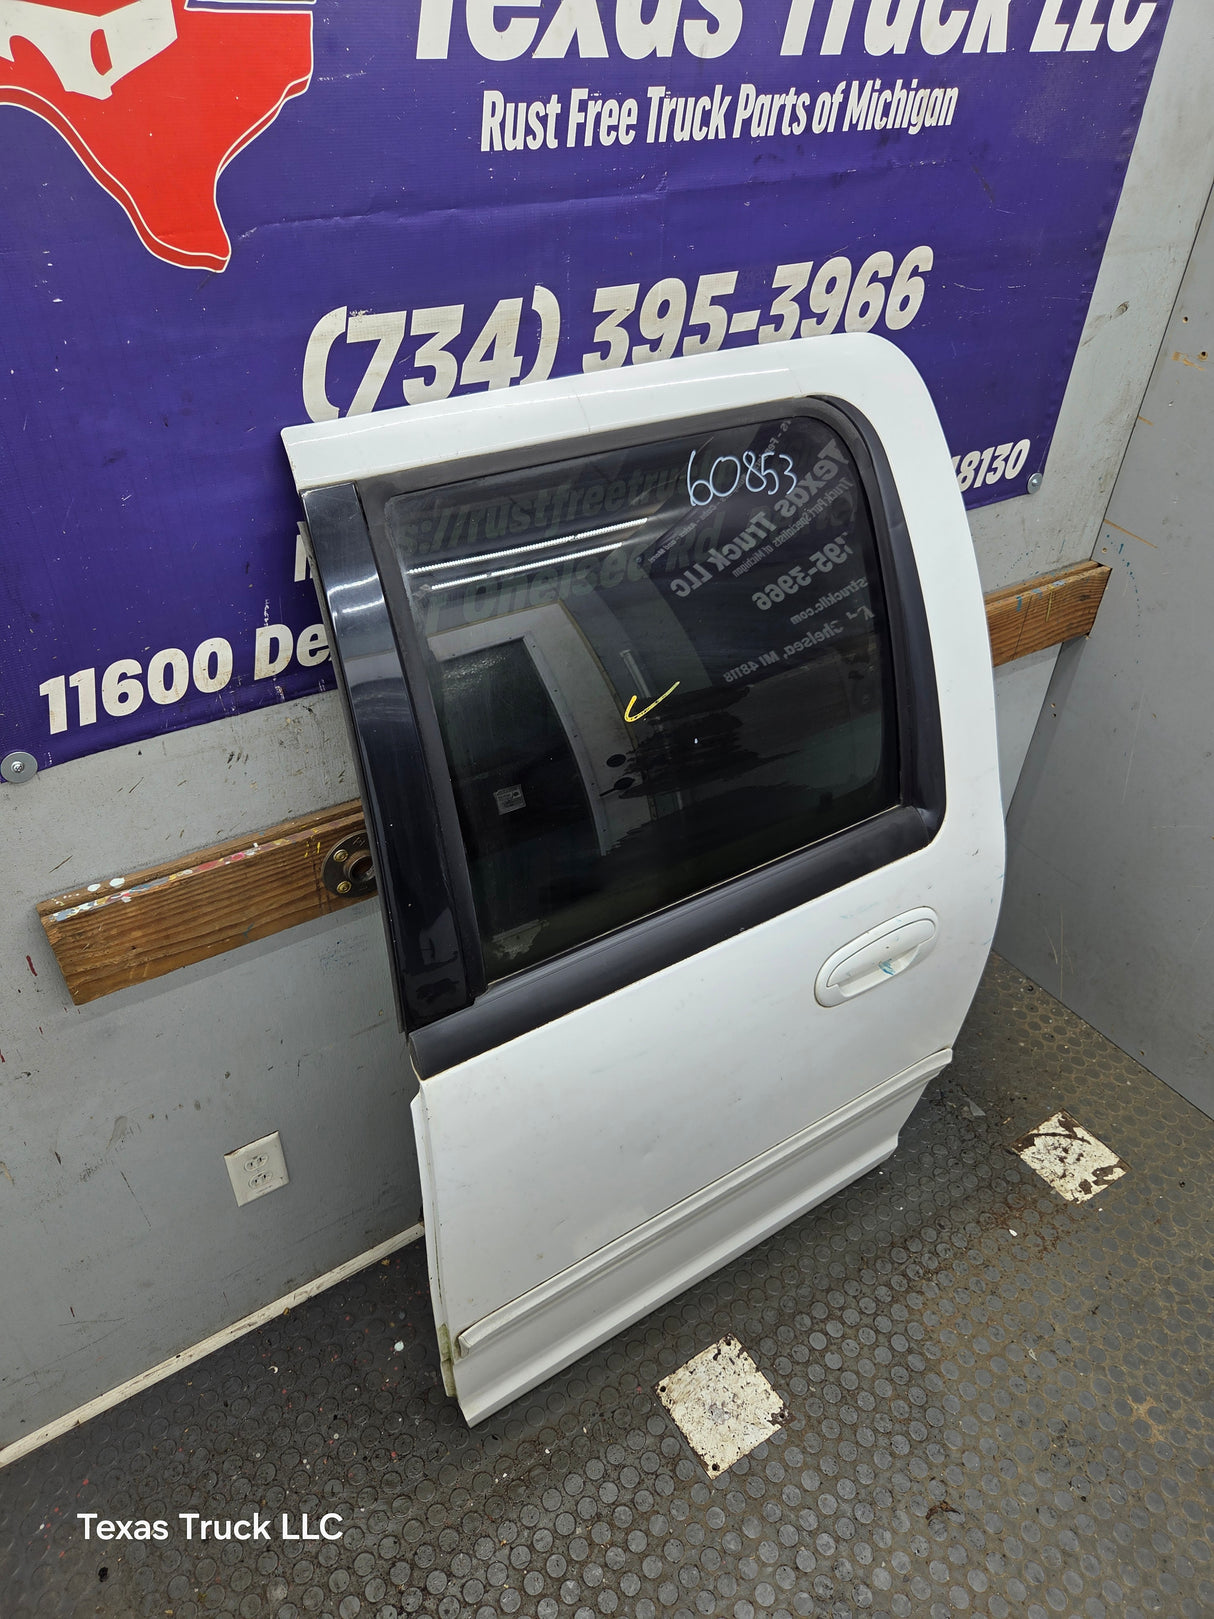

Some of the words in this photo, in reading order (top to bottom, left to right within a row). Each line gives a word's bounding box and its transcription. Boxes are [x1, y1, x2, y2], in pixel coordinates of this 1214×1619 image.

[481, 90, 561, 152] Rust
[566, 88, 638, 148] Free
[646, 84, 735, 143] Truck
[733, 83, 810, 138] Parts
[812, 81, 847, 133] of
[842, 78, 959, 135] Michigan
[302, 284, 561, 423] (734)
[582, 245, 934, 373] 395-3966
[687, 450, 797, 507] 60853
[39, 636, 234, 735] 11600
